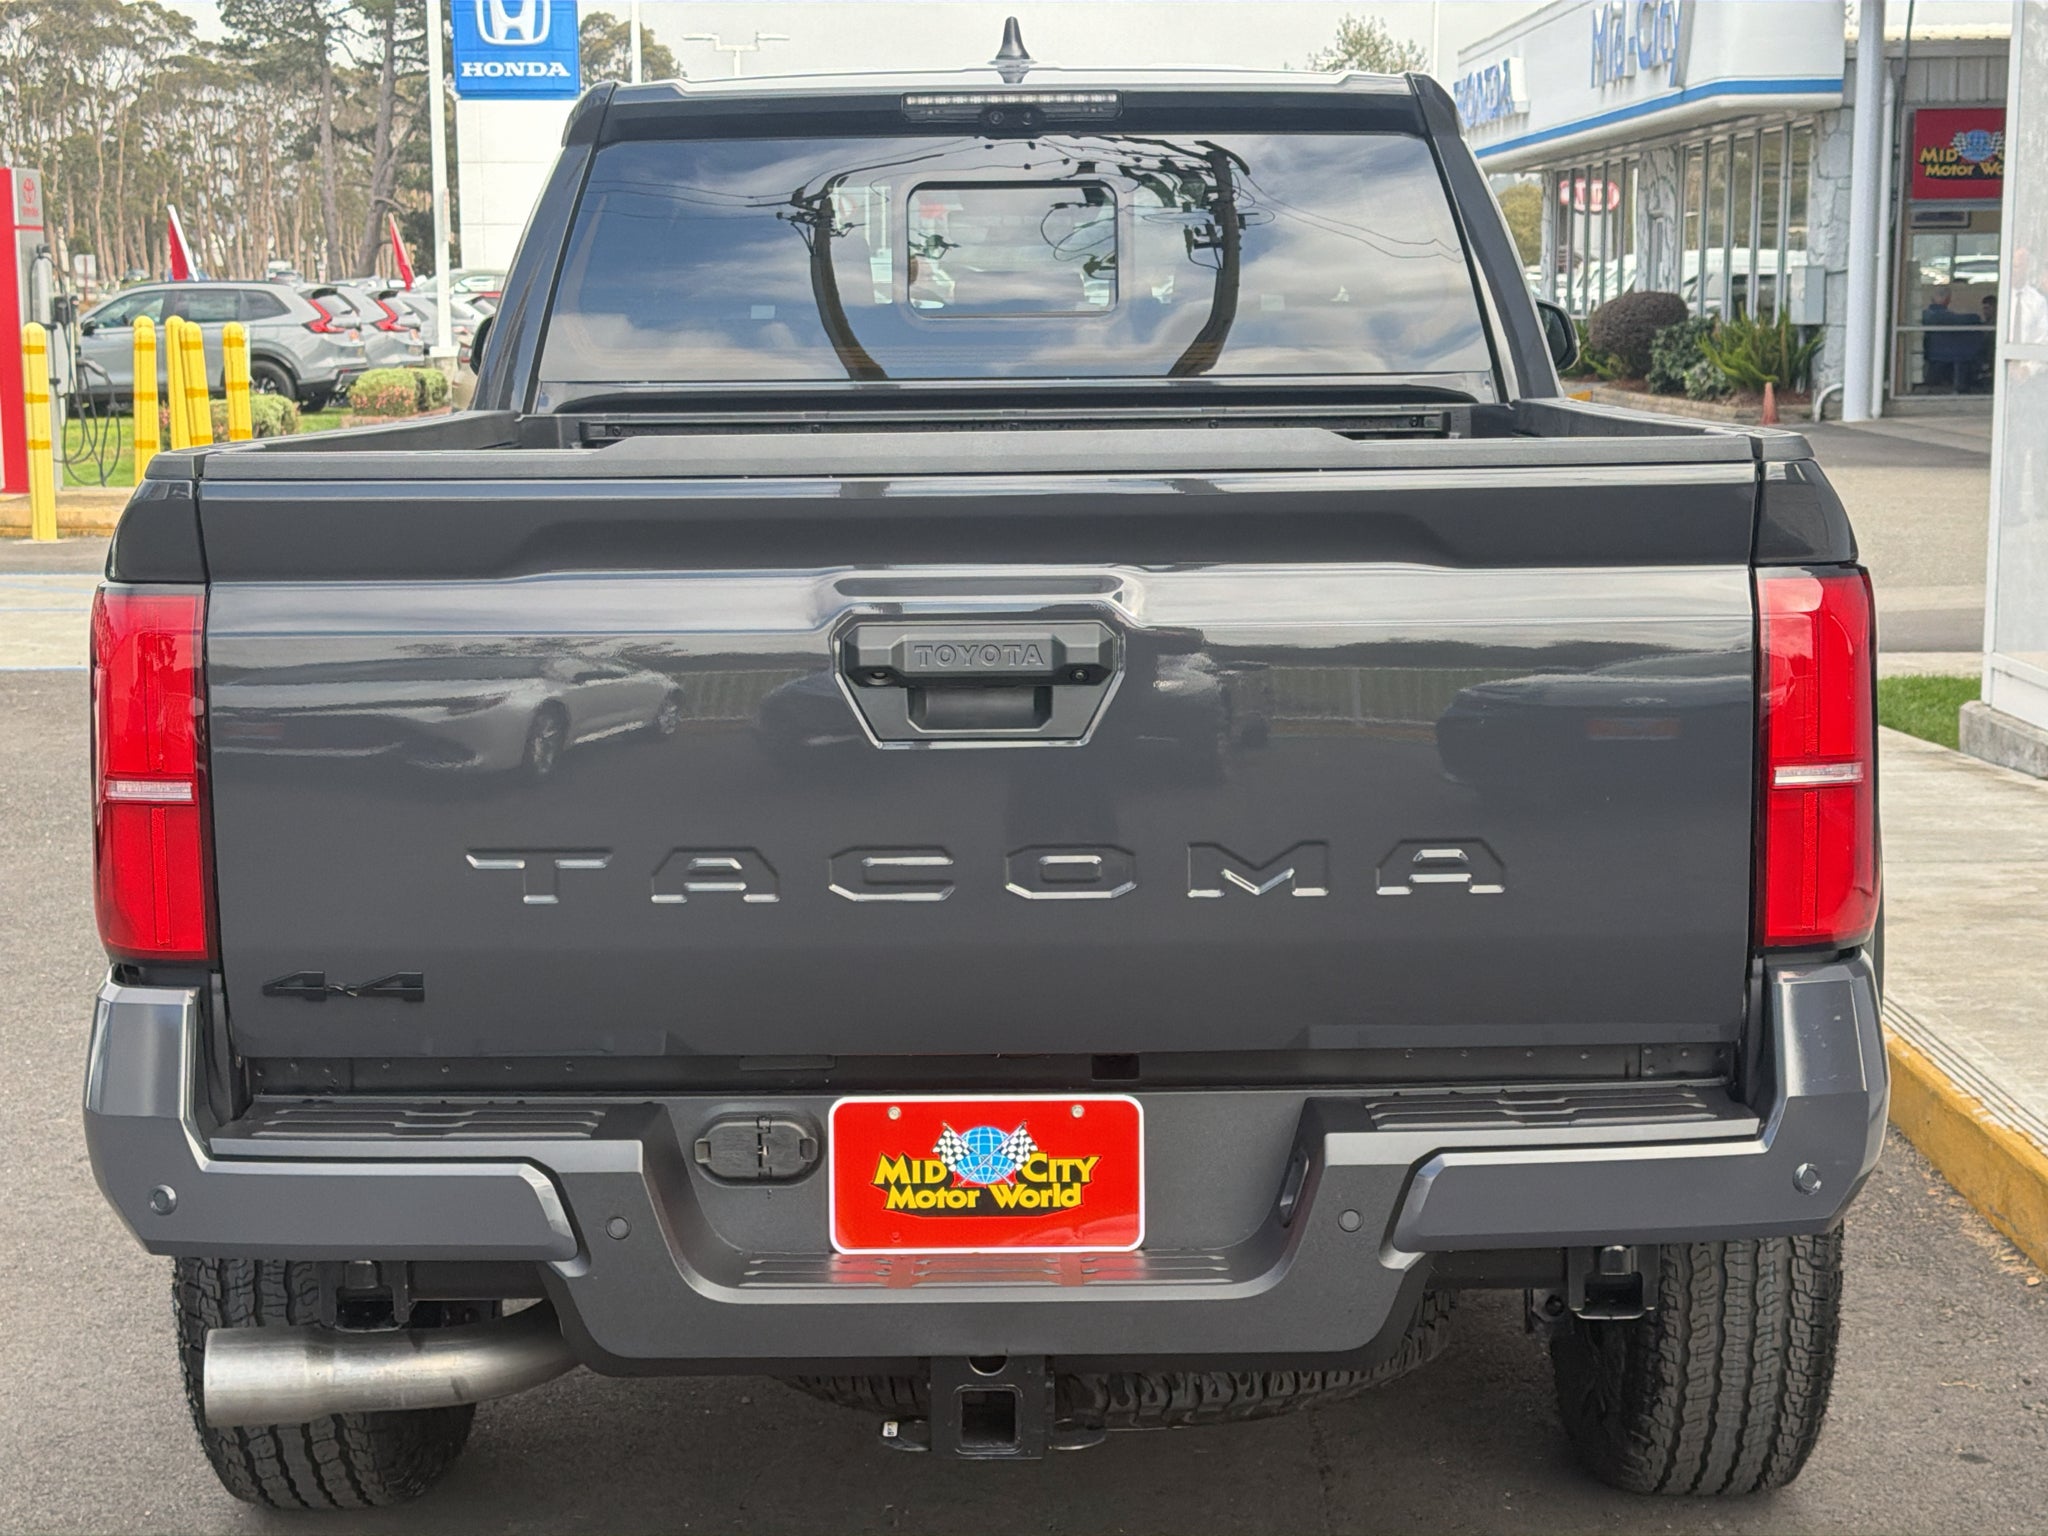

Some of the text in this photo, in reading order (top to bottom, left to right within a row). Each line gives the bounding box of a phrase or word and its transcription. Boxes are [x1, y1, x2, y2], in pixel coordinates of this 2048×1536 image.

[460, 61, 571, 78] HONDA
[1919, 147, 1958, 163] MID
[1925, 163, 1975, 177] Motor
[913, 643, 1045, 668] TOYOTA
[466, 838, 1506, 904] TACOMA
[873, 1152, 1099, 1185] MID CITY
[885, 1183, 1082, 1209] Motor World
